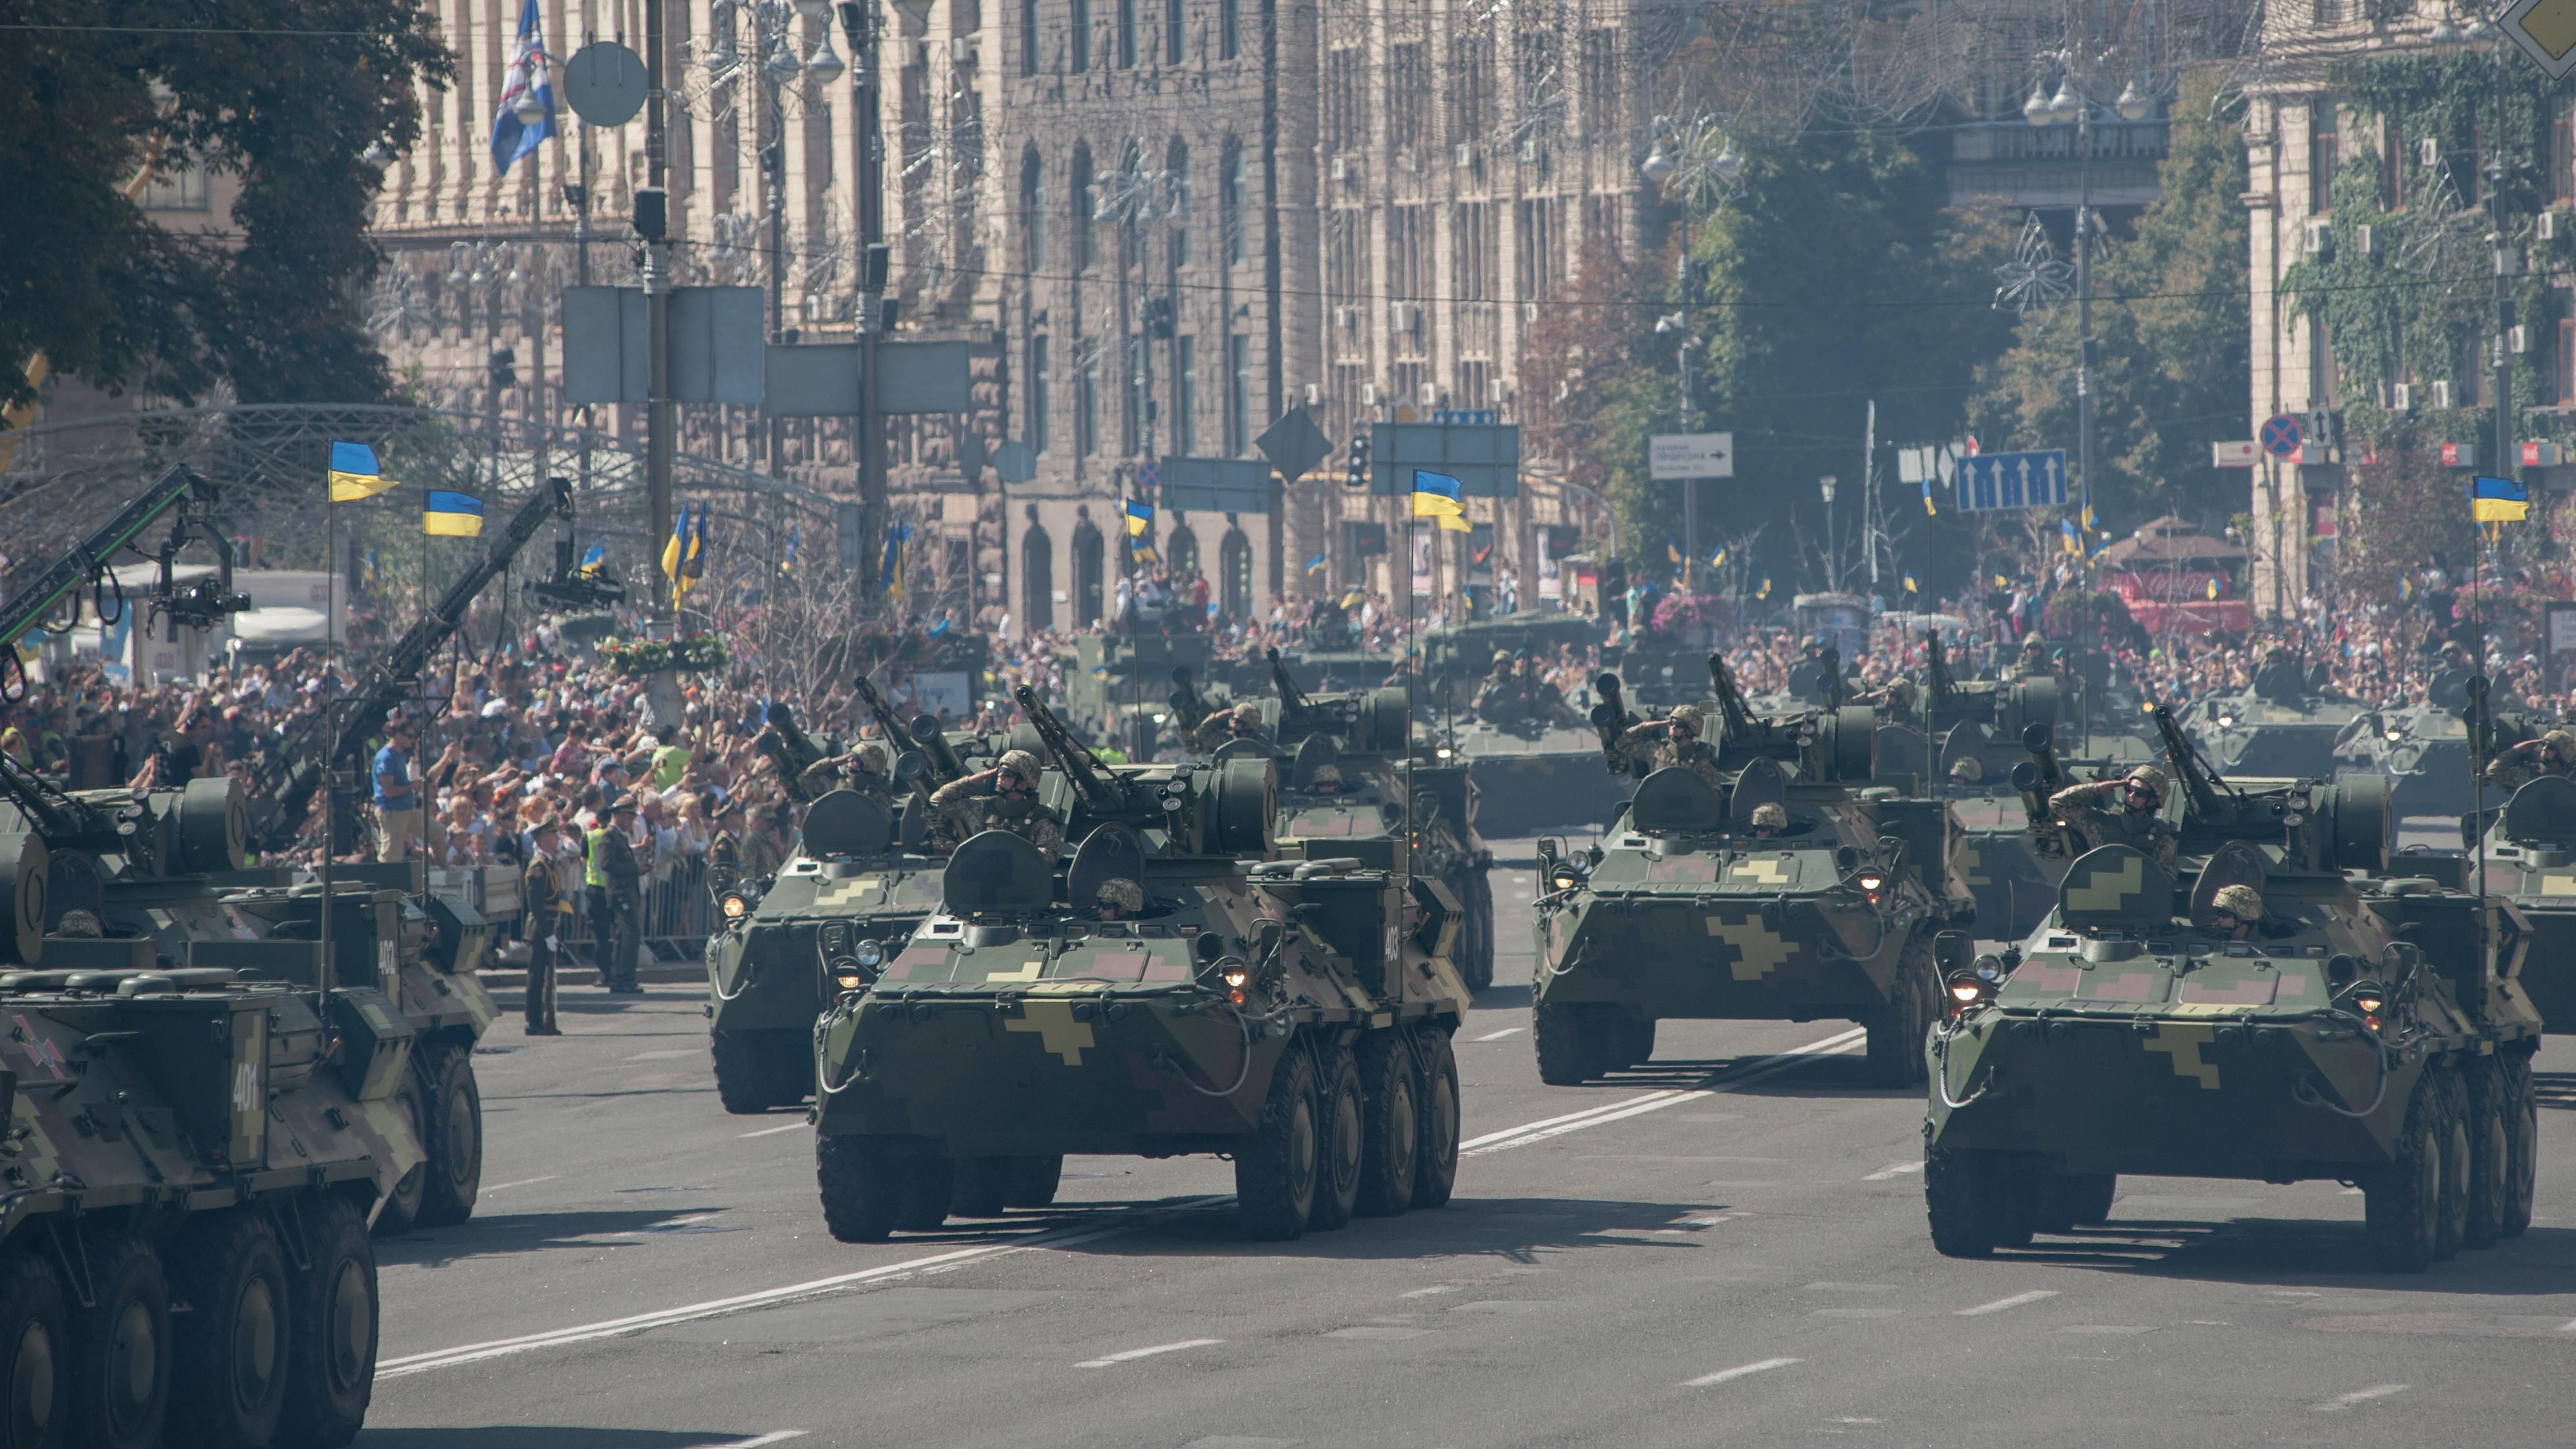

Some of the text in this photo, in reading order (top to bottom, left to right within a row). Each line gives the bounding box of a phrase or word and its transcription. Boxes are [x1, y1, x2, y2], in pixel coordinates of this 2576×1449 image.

[378, 940, 395, 975] 402
[1385, 926, 1398, 962] 403
[233, 1063, 257, 1112] 401
